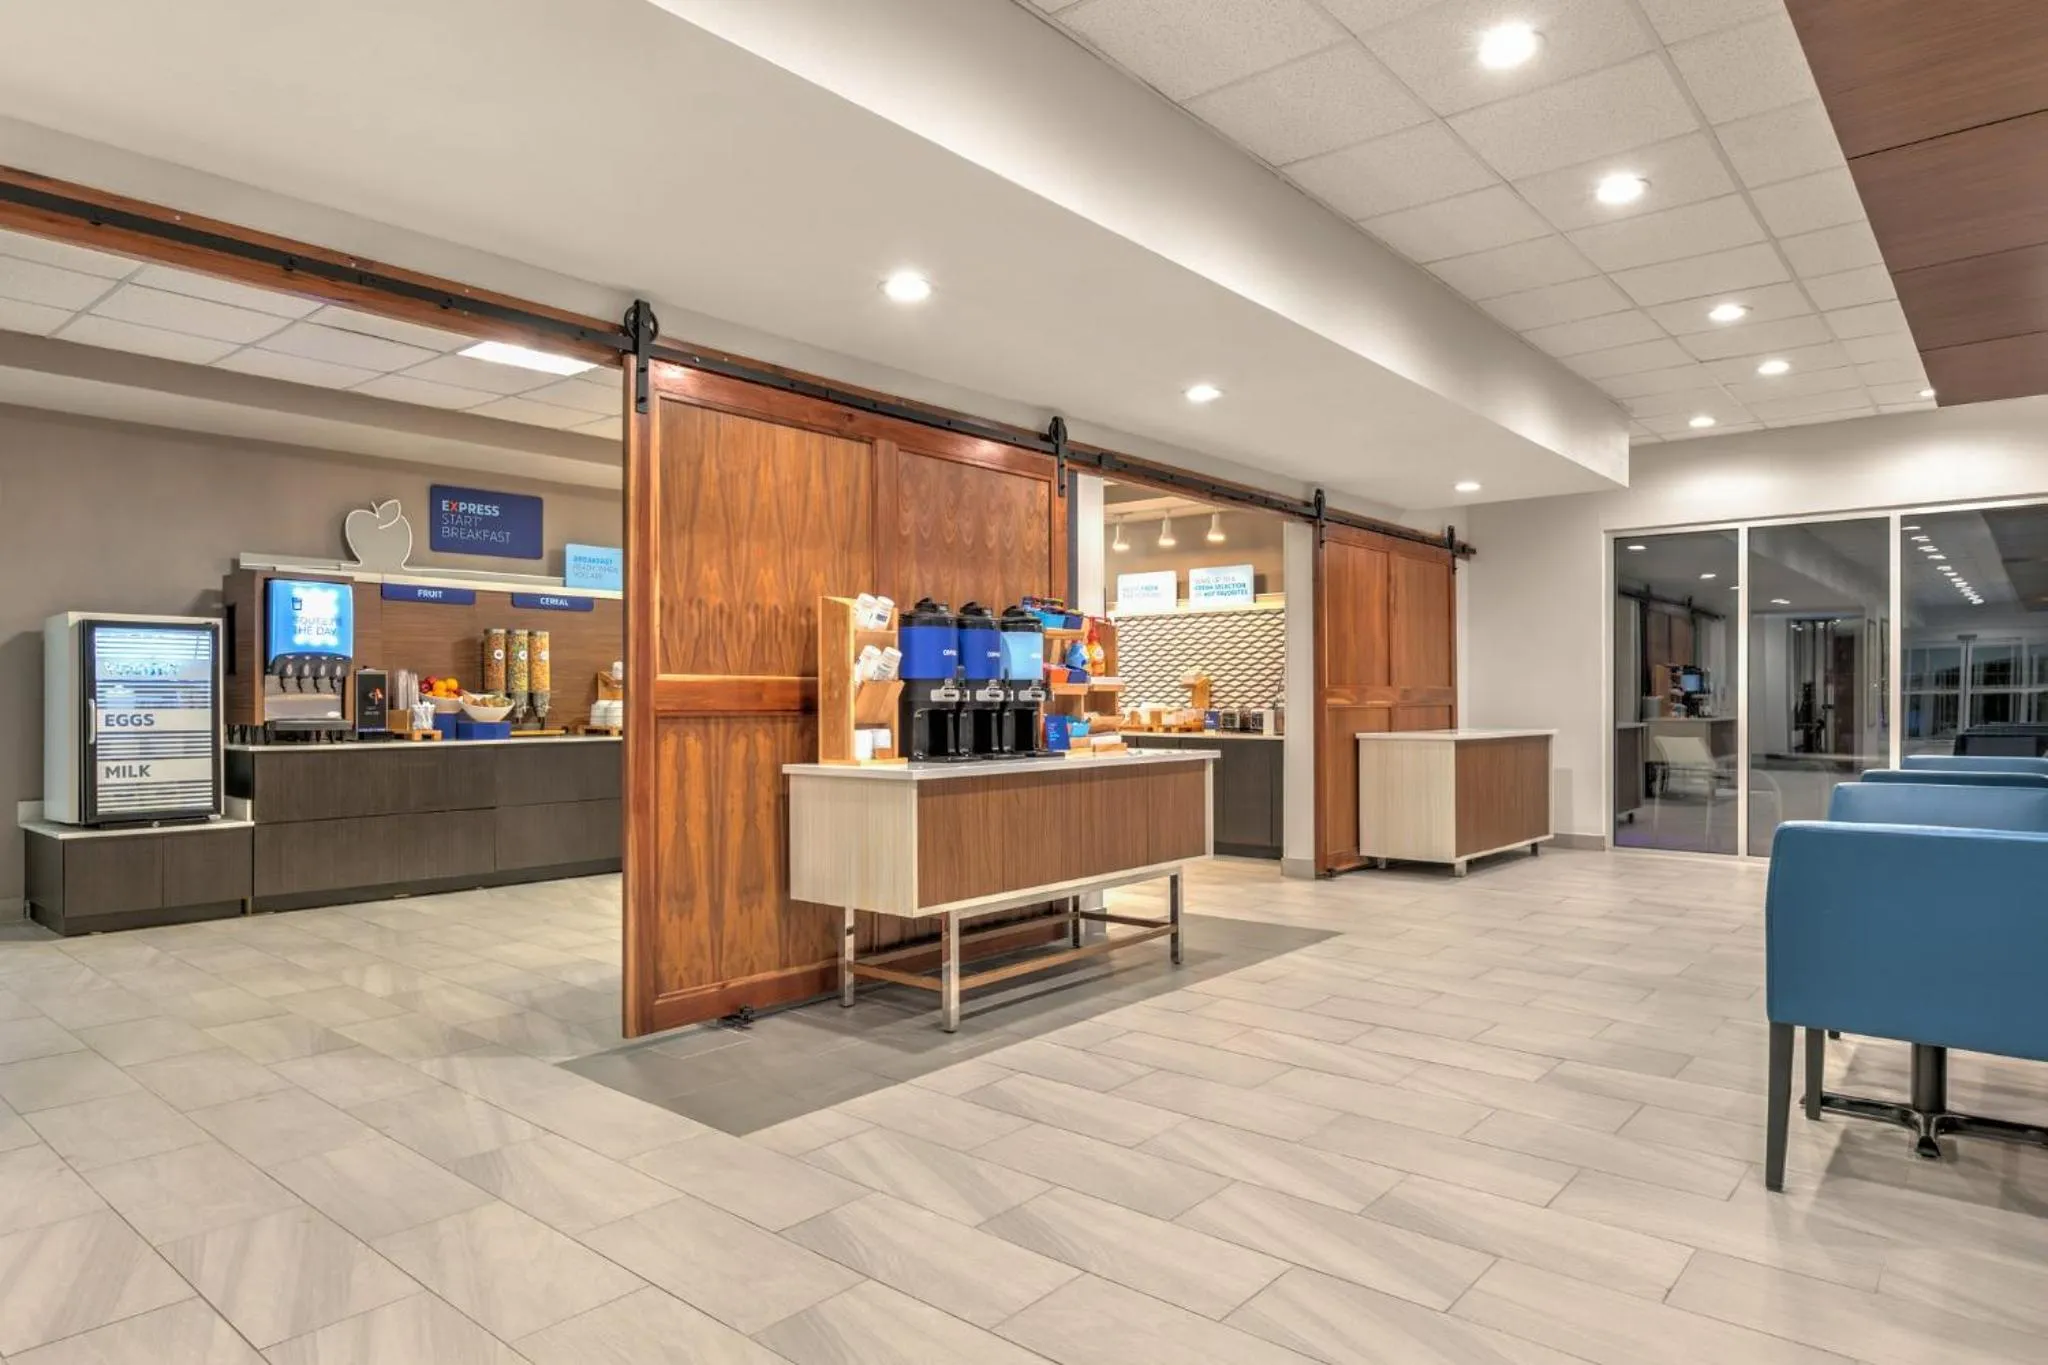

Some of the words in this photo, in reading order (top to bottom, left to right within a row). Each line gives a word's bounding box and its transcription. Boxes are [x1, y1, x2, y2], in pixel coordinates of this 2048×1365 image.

[441, 499, 500, 517] EXPRESS
[441, 527, 511, 544] BREAKFAST
[417, 589, 443, 598] FRUIT
[540, 597, 569, 606] CEREAL
[293, 625, 313, 635] THE
[316, 625, 337, 636] DAY
[104, 713, 155, 727] EGGS
[104, 765, 151, 779] MILK
